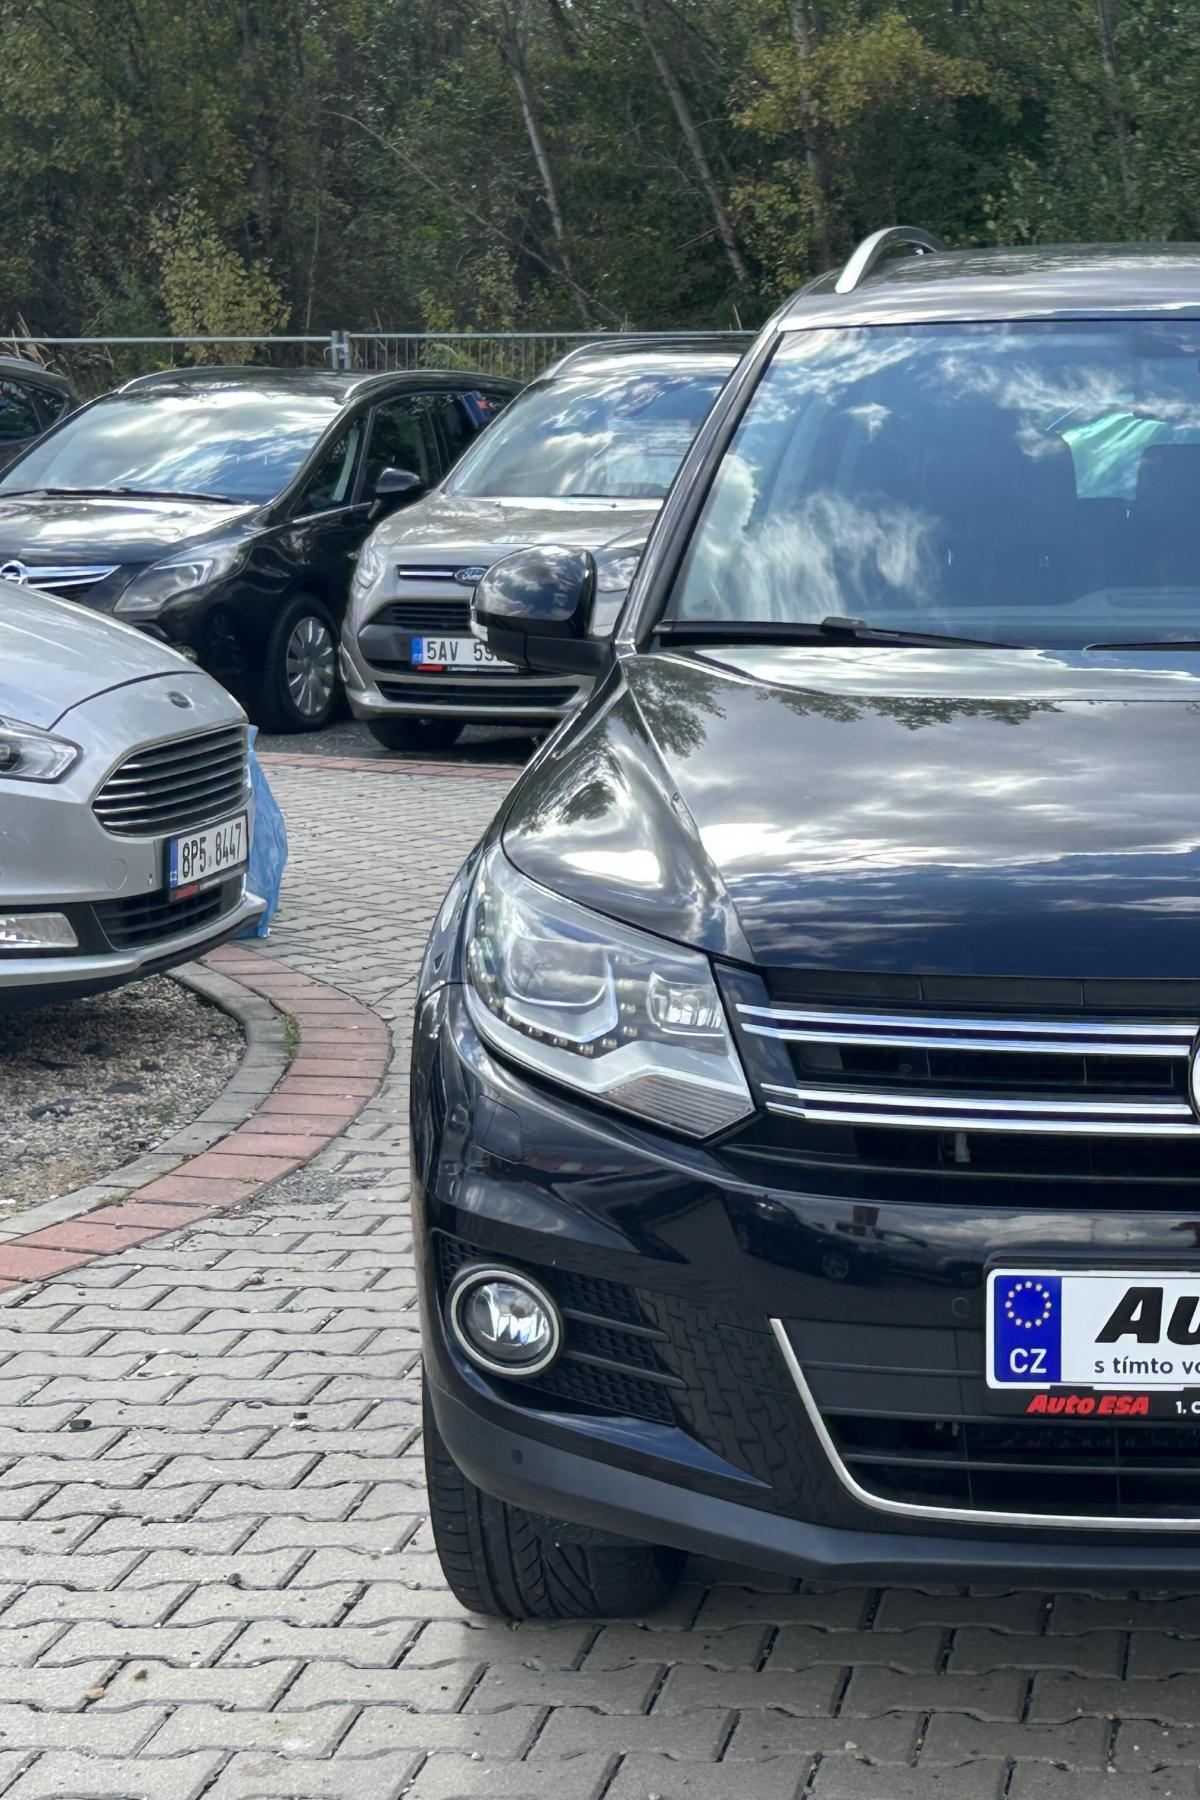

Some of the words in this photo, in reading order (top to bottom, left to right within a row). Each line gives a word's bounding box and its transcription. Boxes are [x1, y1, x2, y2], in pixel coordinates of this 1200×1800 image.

[426, 640, 458, 661] 5AV
[182, 836, 207, 879] 8P5
[215, 821, 242, 867] 8447
[1009, 1347, 1048, 1374] CZ
[1093, 1360, 1105, 1374] s
[1112, 1355, 1174, 1375] tímto
[1026, 1394, 1096, 1415] Auto
[1096, 1395, 1150, 1416] ESA
[1175, 1400, 1187, 1415] 1.
